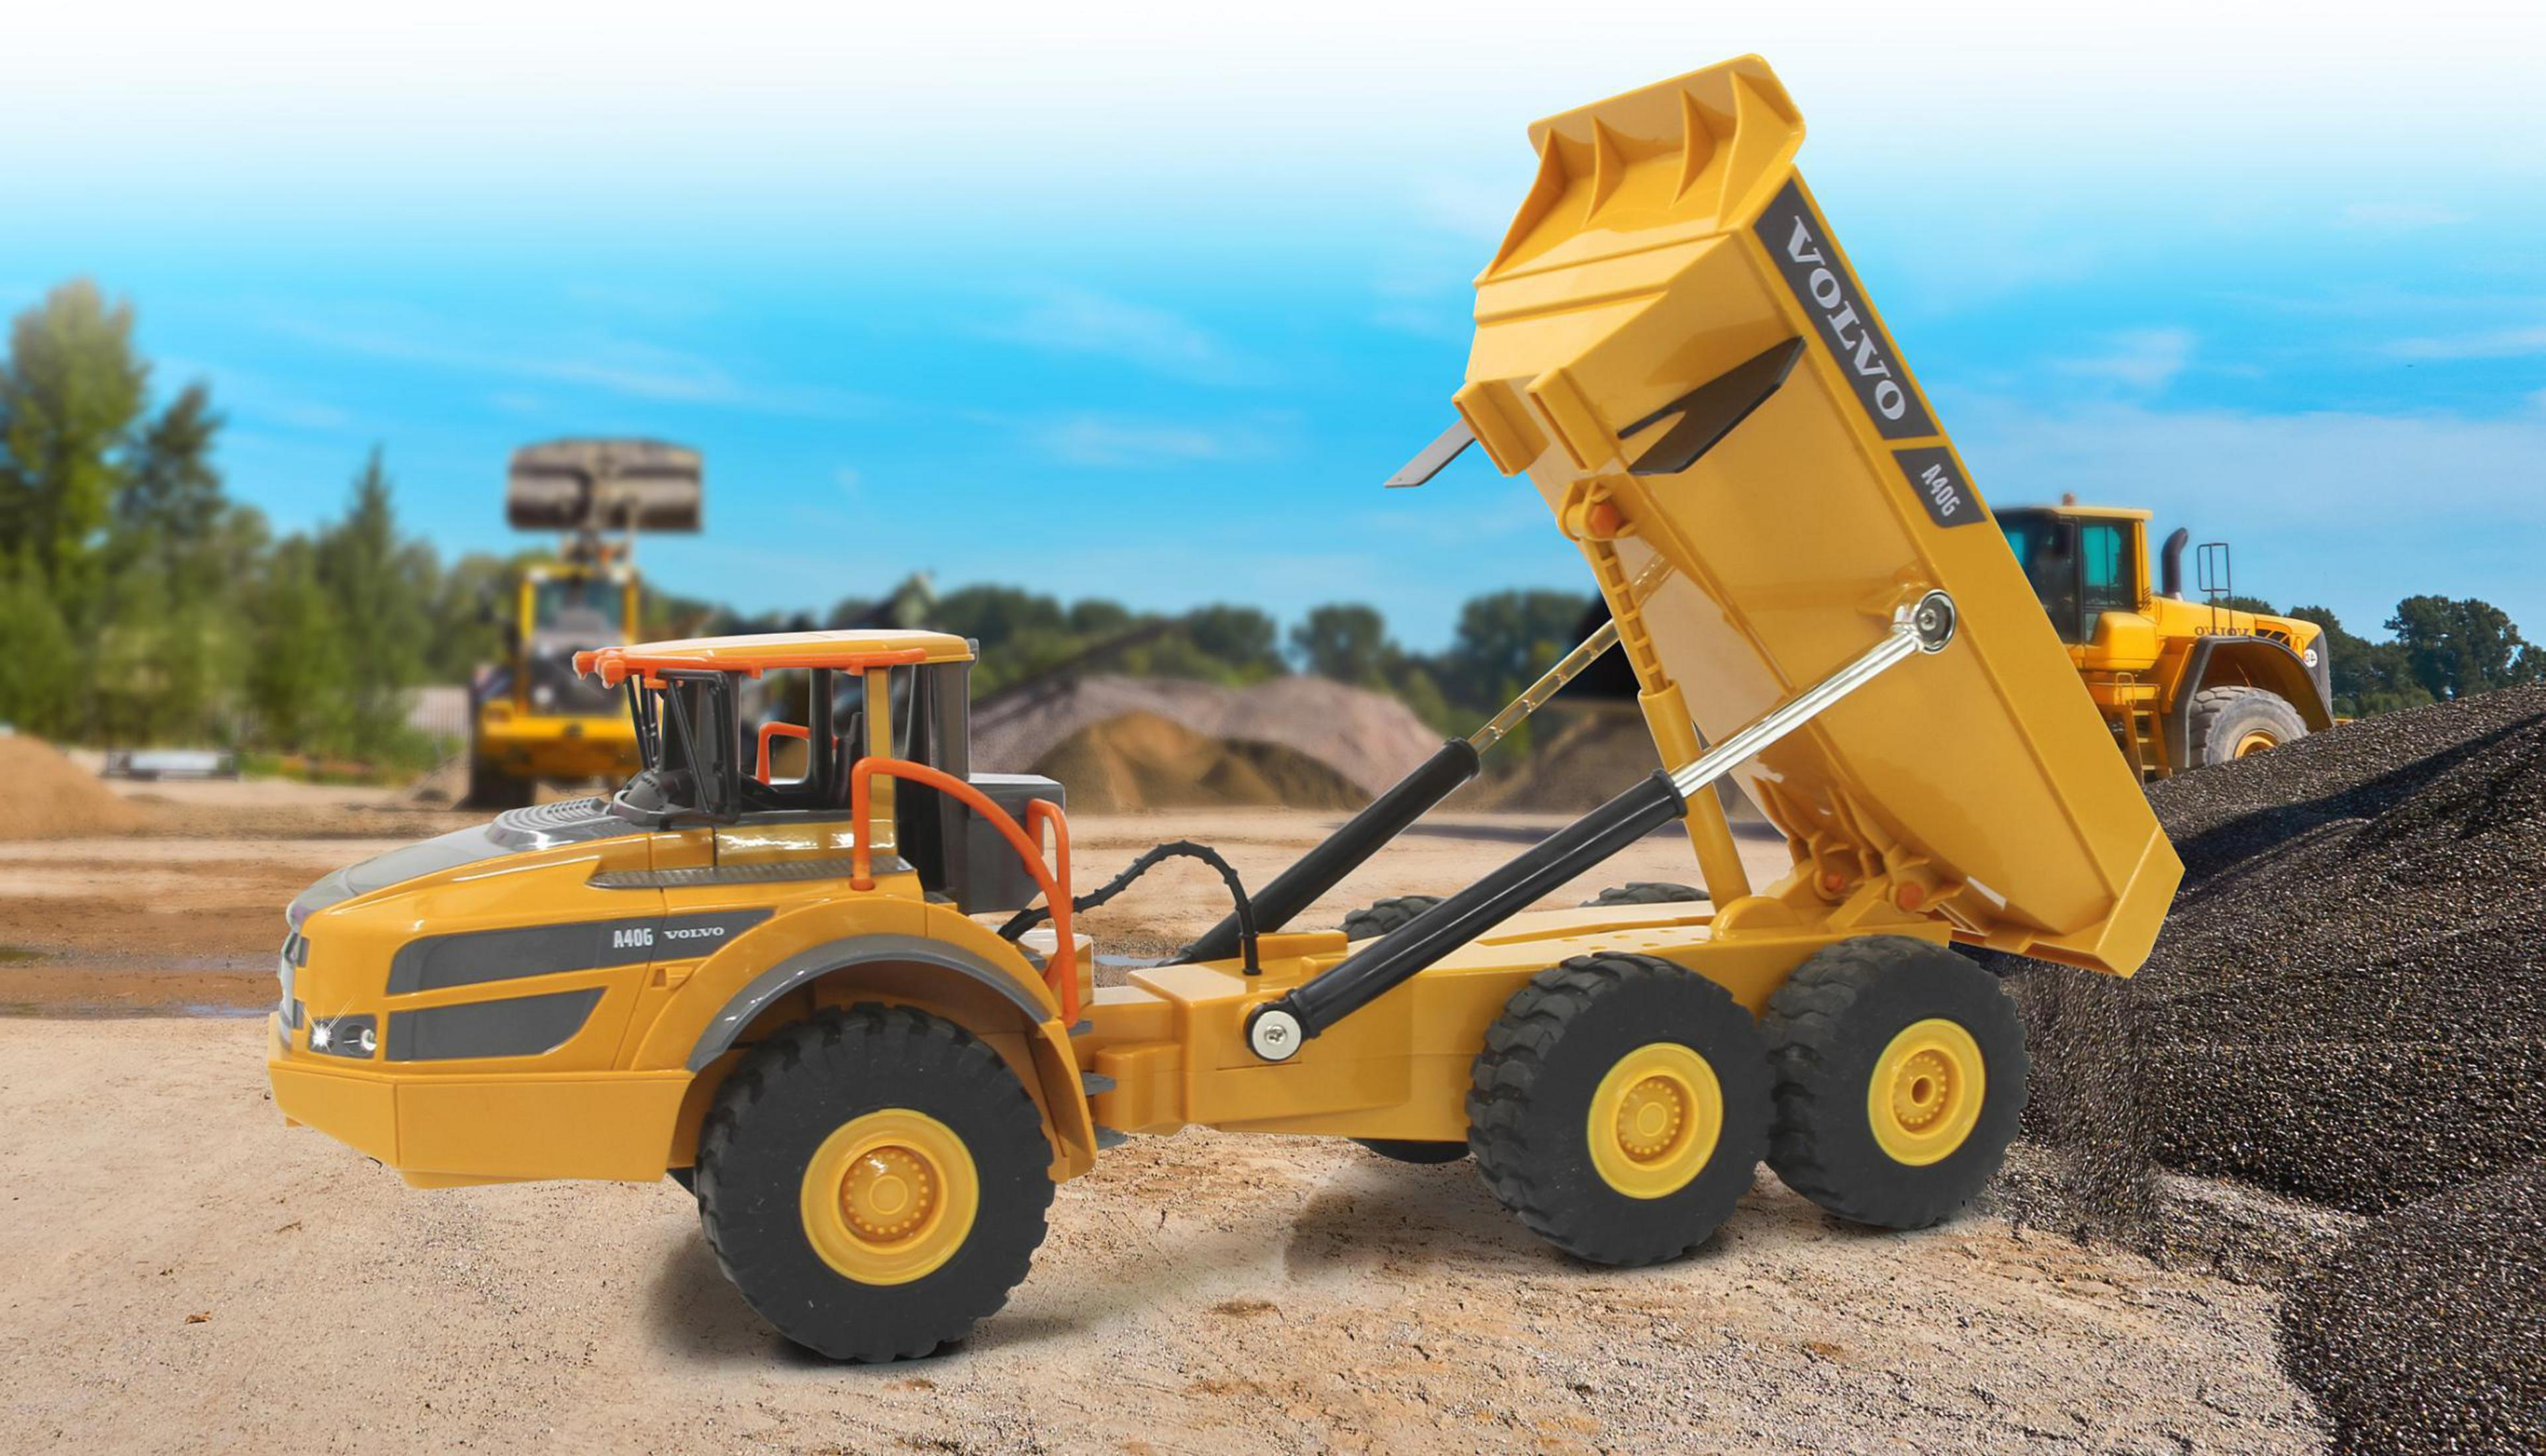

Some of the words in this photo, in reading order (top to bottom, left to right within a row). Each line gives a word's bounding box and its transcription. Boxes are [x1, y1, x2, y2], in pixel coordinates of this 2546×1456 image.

[1787, 216, 1906, 420] VOLVO
[1922, 464, 1961, 517] A40G
[614, 928, 653, 948] A40G
[664, 927, 724, 939] VOLVO
